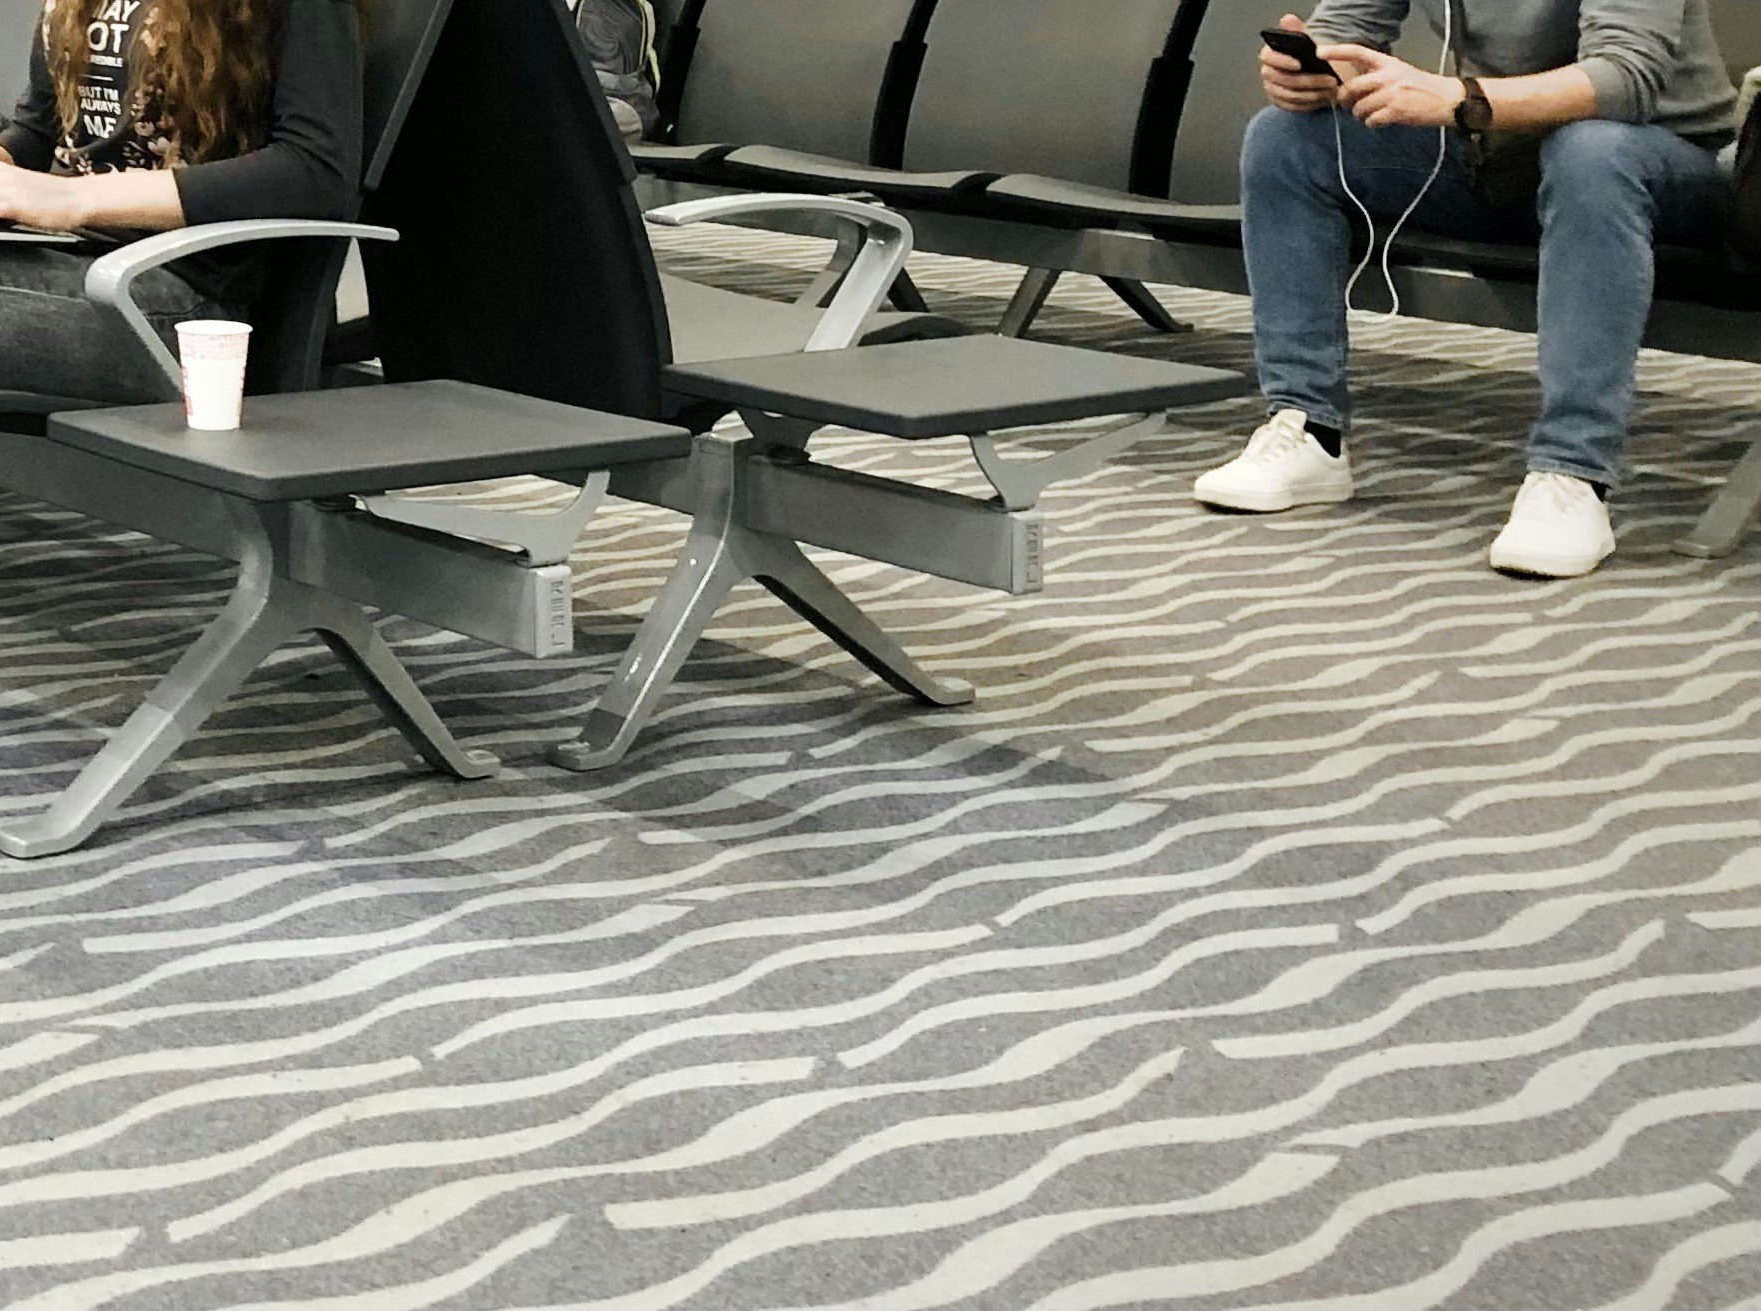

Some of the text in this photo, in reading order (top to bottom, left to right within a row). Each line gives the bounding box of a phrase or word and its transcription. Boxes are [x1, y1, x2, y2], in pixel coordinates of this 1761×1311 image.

[87, 21, 130, 54] OT
[78, 86, 102, 99] BUT
[80, 98, 121, 115] ALWAYS
